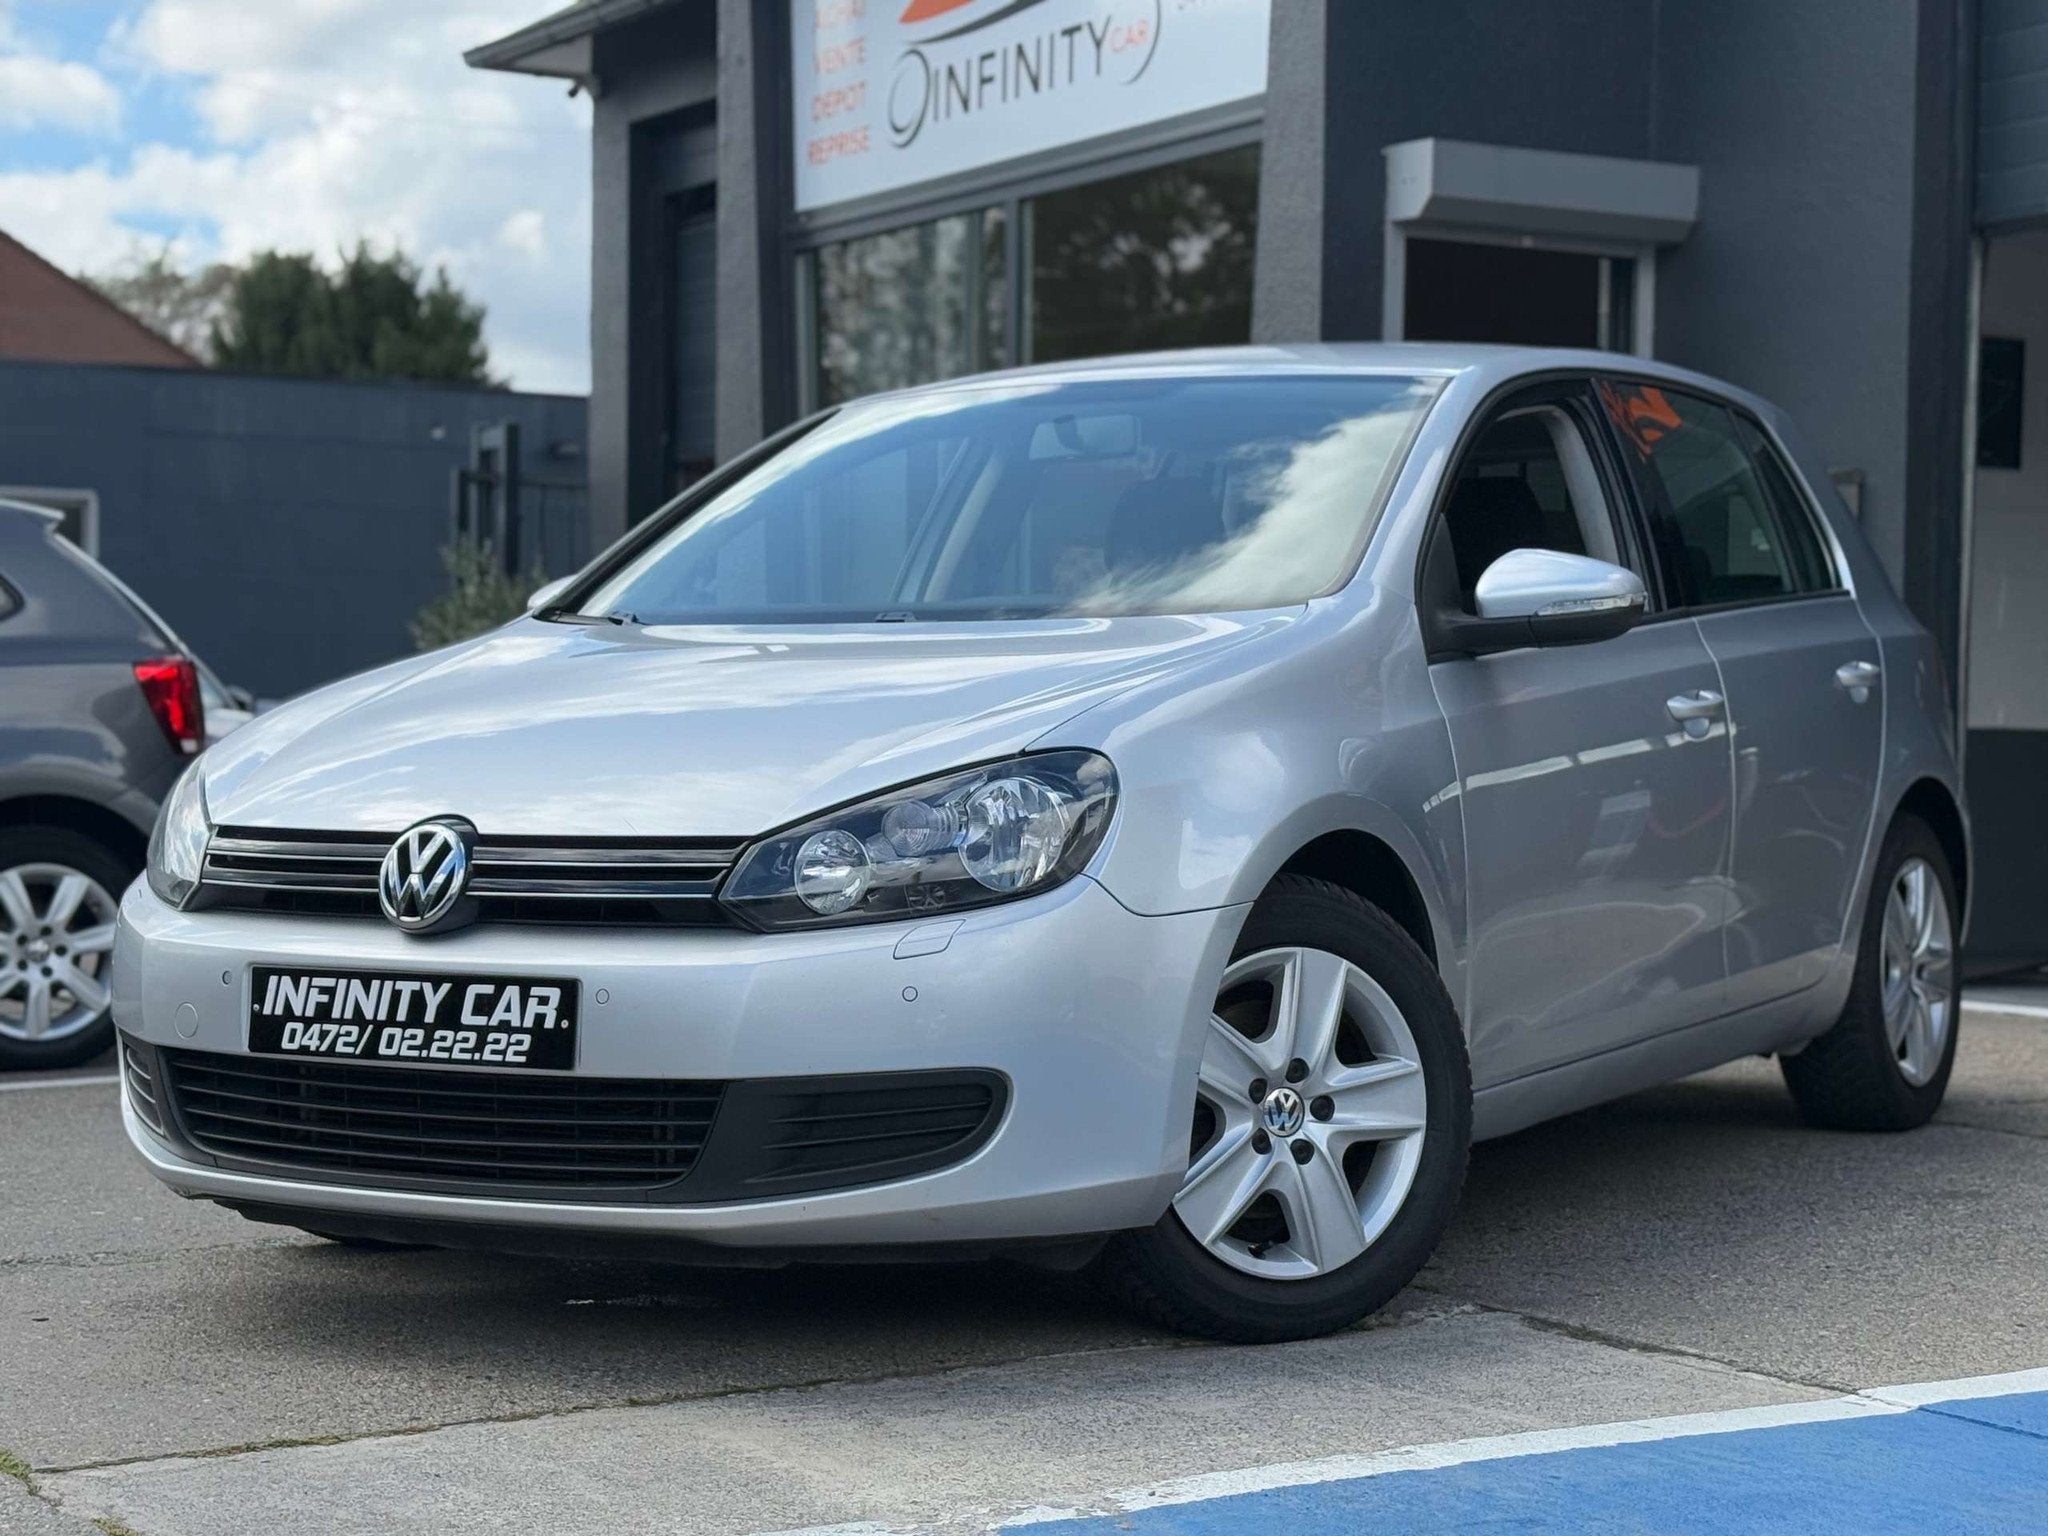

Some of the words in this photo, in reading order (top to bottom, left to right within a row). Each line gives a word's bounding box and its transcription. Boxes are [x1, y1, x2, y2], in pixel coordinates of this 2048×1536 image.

[932, 15, 1112, 122] INFINITY
[1108, 18, 1149, 54] CAR
[262, 974, 452, 1023] INFINITY
[460, 983, 561, 1029] CAR
[281, 1021, 373, 1055] 0472/
[378, 1026, 532, 1062] 02.22.22
